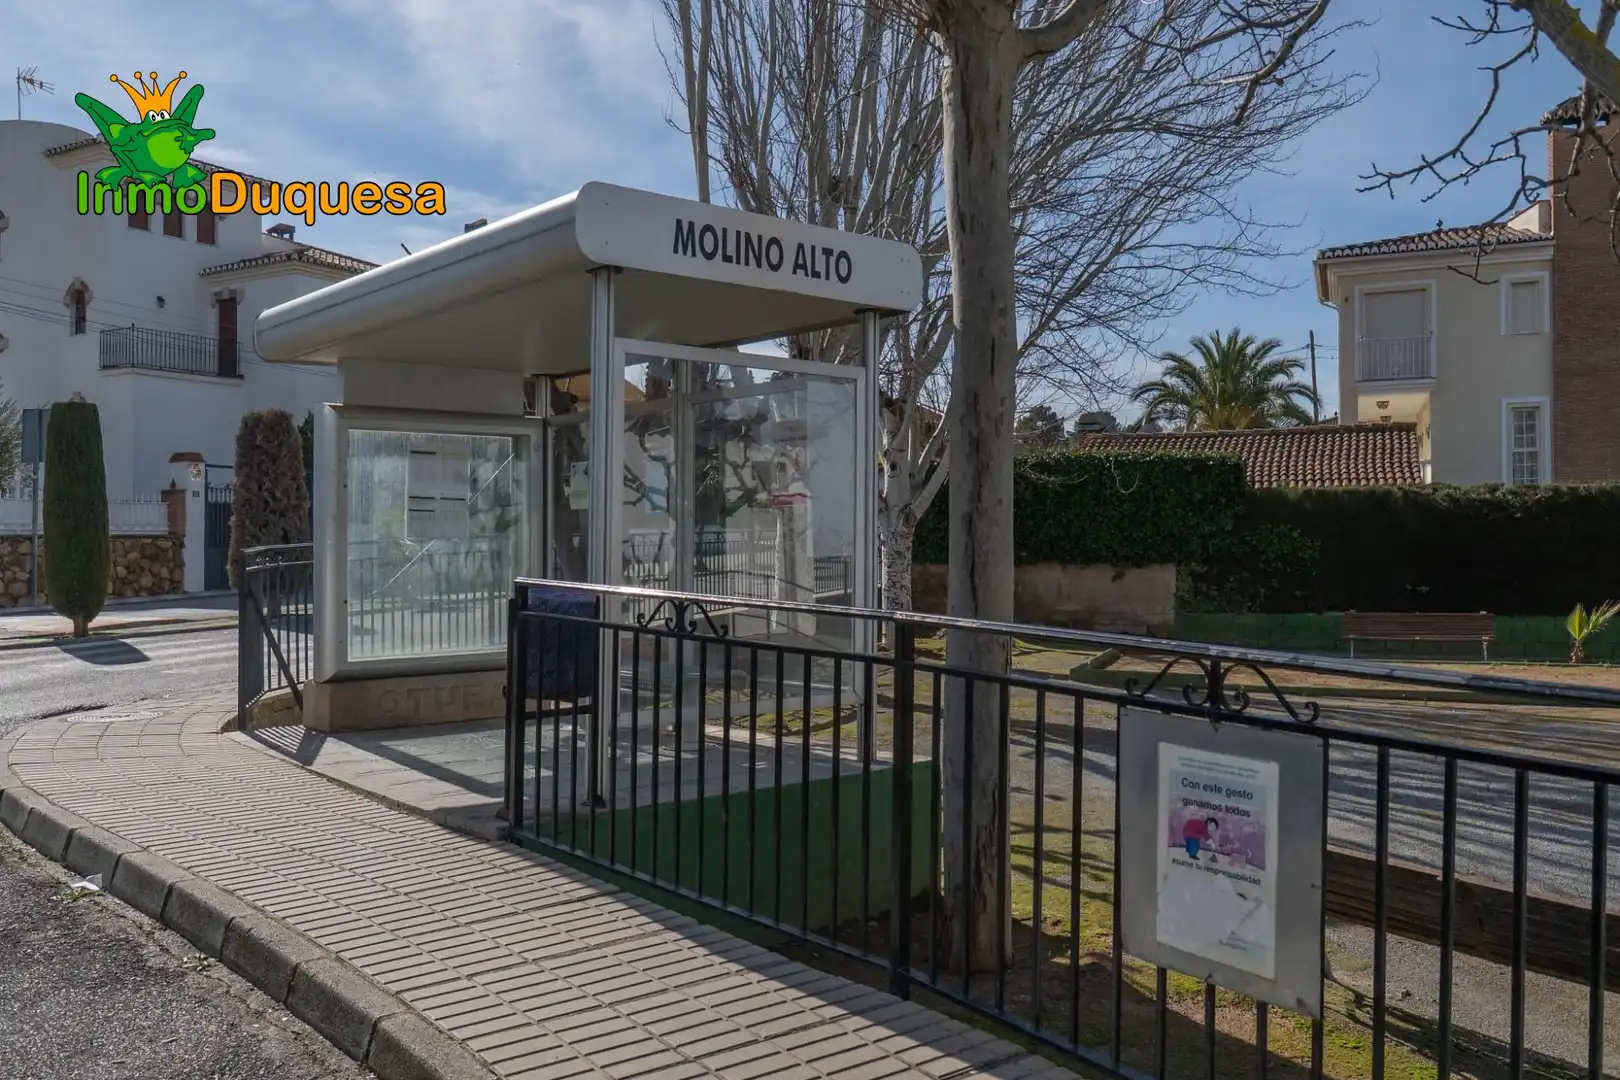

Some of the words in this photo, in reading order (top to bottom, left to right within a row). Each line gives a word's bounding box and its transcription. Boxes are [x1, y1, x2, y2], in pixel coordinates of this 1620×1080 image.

[672, 217, 785, 273] MOLINO
[791, 241, 853, 285] ALTO
[1181, 777, 1200, 791] Con
[1202, 783, 1223, 794] este
[1225, 789, 1254, 800] gesto
[1181, 798, 1223, 812] ganamos
[1225, 804, 1251, 818] todos
[1203, 865, 1261, 886] responsabilidad
